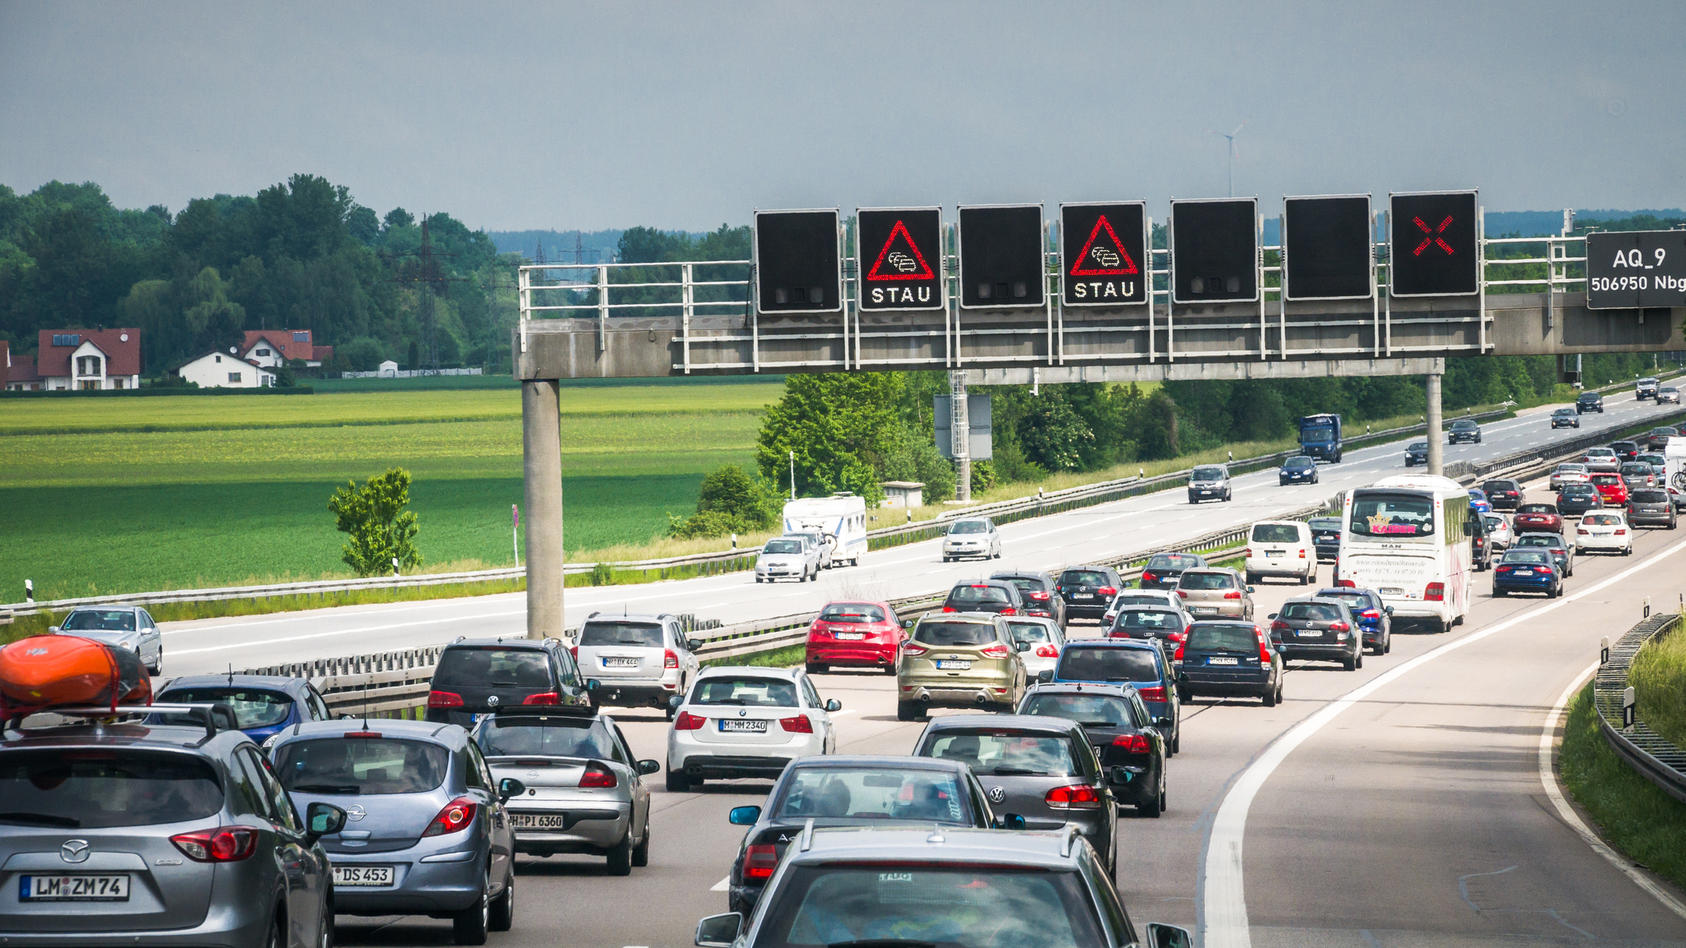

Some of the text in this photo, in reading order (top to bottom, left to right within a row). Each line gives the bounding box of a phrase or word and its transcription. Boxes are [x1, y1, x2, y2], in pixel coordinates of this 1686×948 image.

[1612, 248, 1666, 269] AQ_9
[1074, 281, 1134, 298] STAU
[1591, 275, 1686, 292] 506950 Nbg
[871, 286, 930, 303] STAU
[1372, 525, 1416, 534] KAISER
[746, 721, 766, 729] 2340
[538, 816, 562, 826] 6360
[343, 868, 388, 881] DS 453
[36, 878, 60, 895] LM
